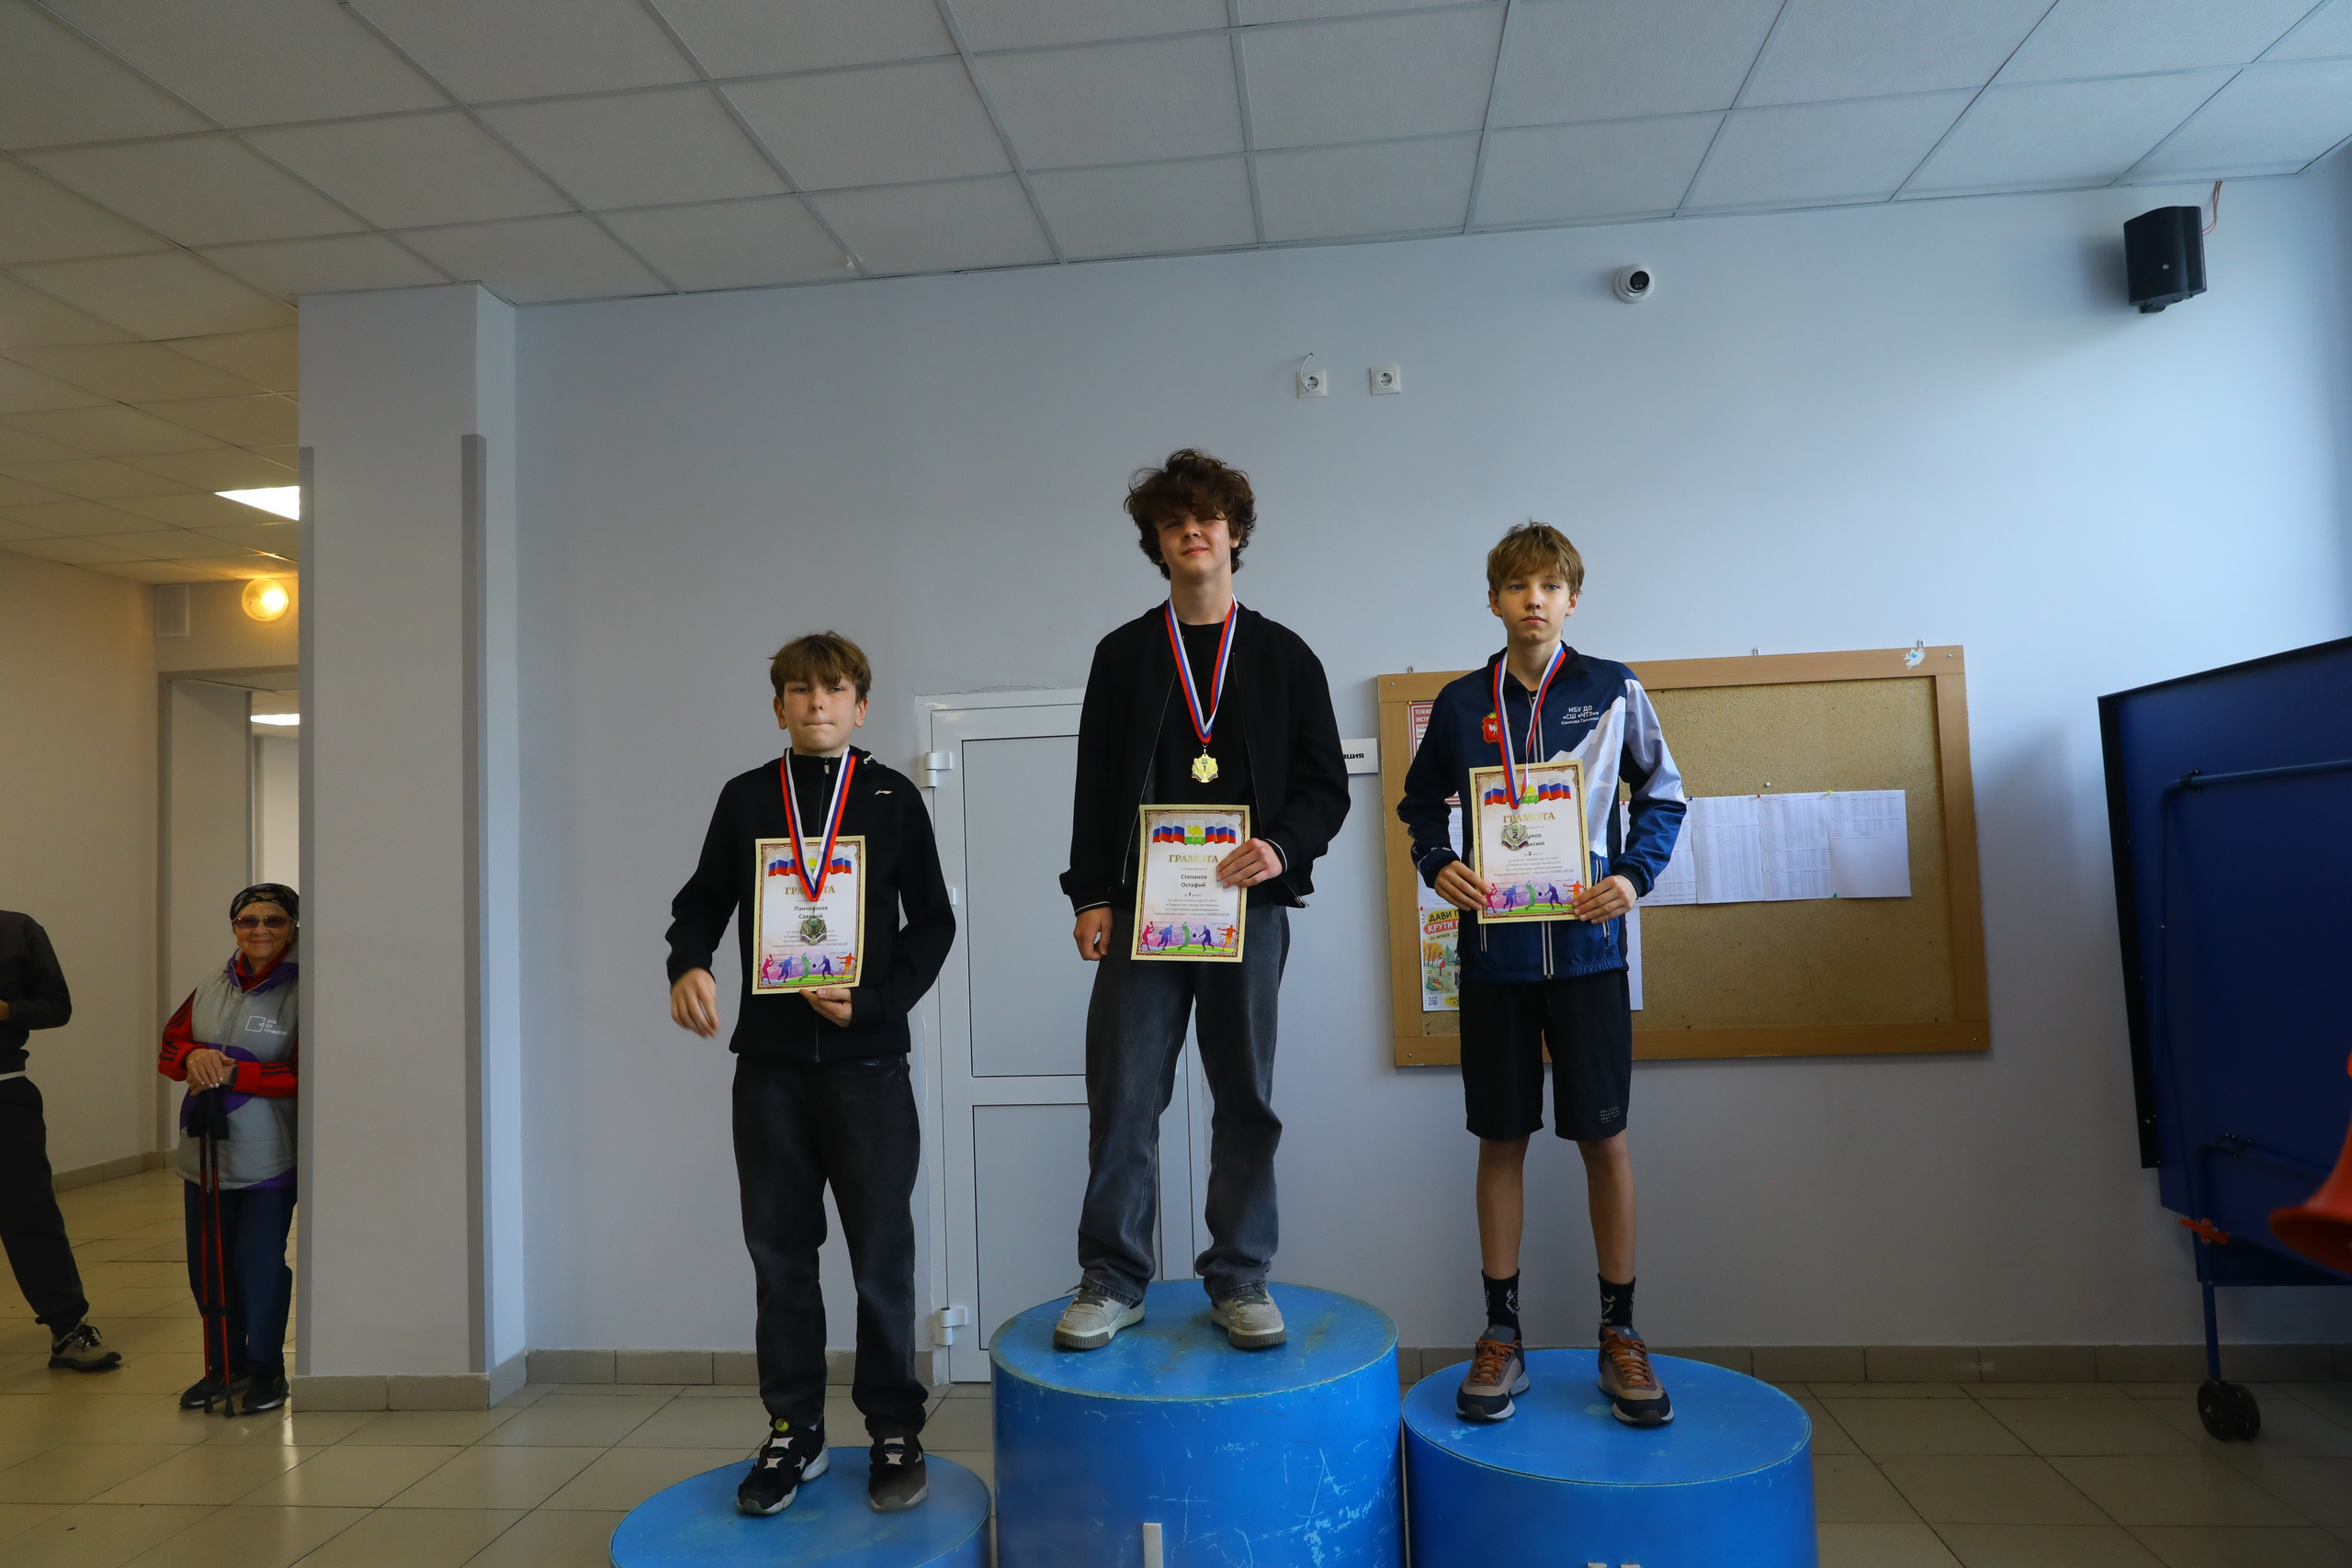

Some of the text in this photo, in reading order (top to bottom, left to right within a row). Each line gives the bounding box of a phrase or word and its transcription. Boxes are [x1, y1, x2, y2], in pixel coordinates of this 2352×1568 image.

[1502, 812, 1555, 824] ГРАМОТА
[1168, 854, 1218, 863] ГРАМОТА
[785, 886, 835, 895] ГРАТА
[1429, 910, 1452, 922] ДАВИ
[1428, 919, 1453, 933] КРУТИ
